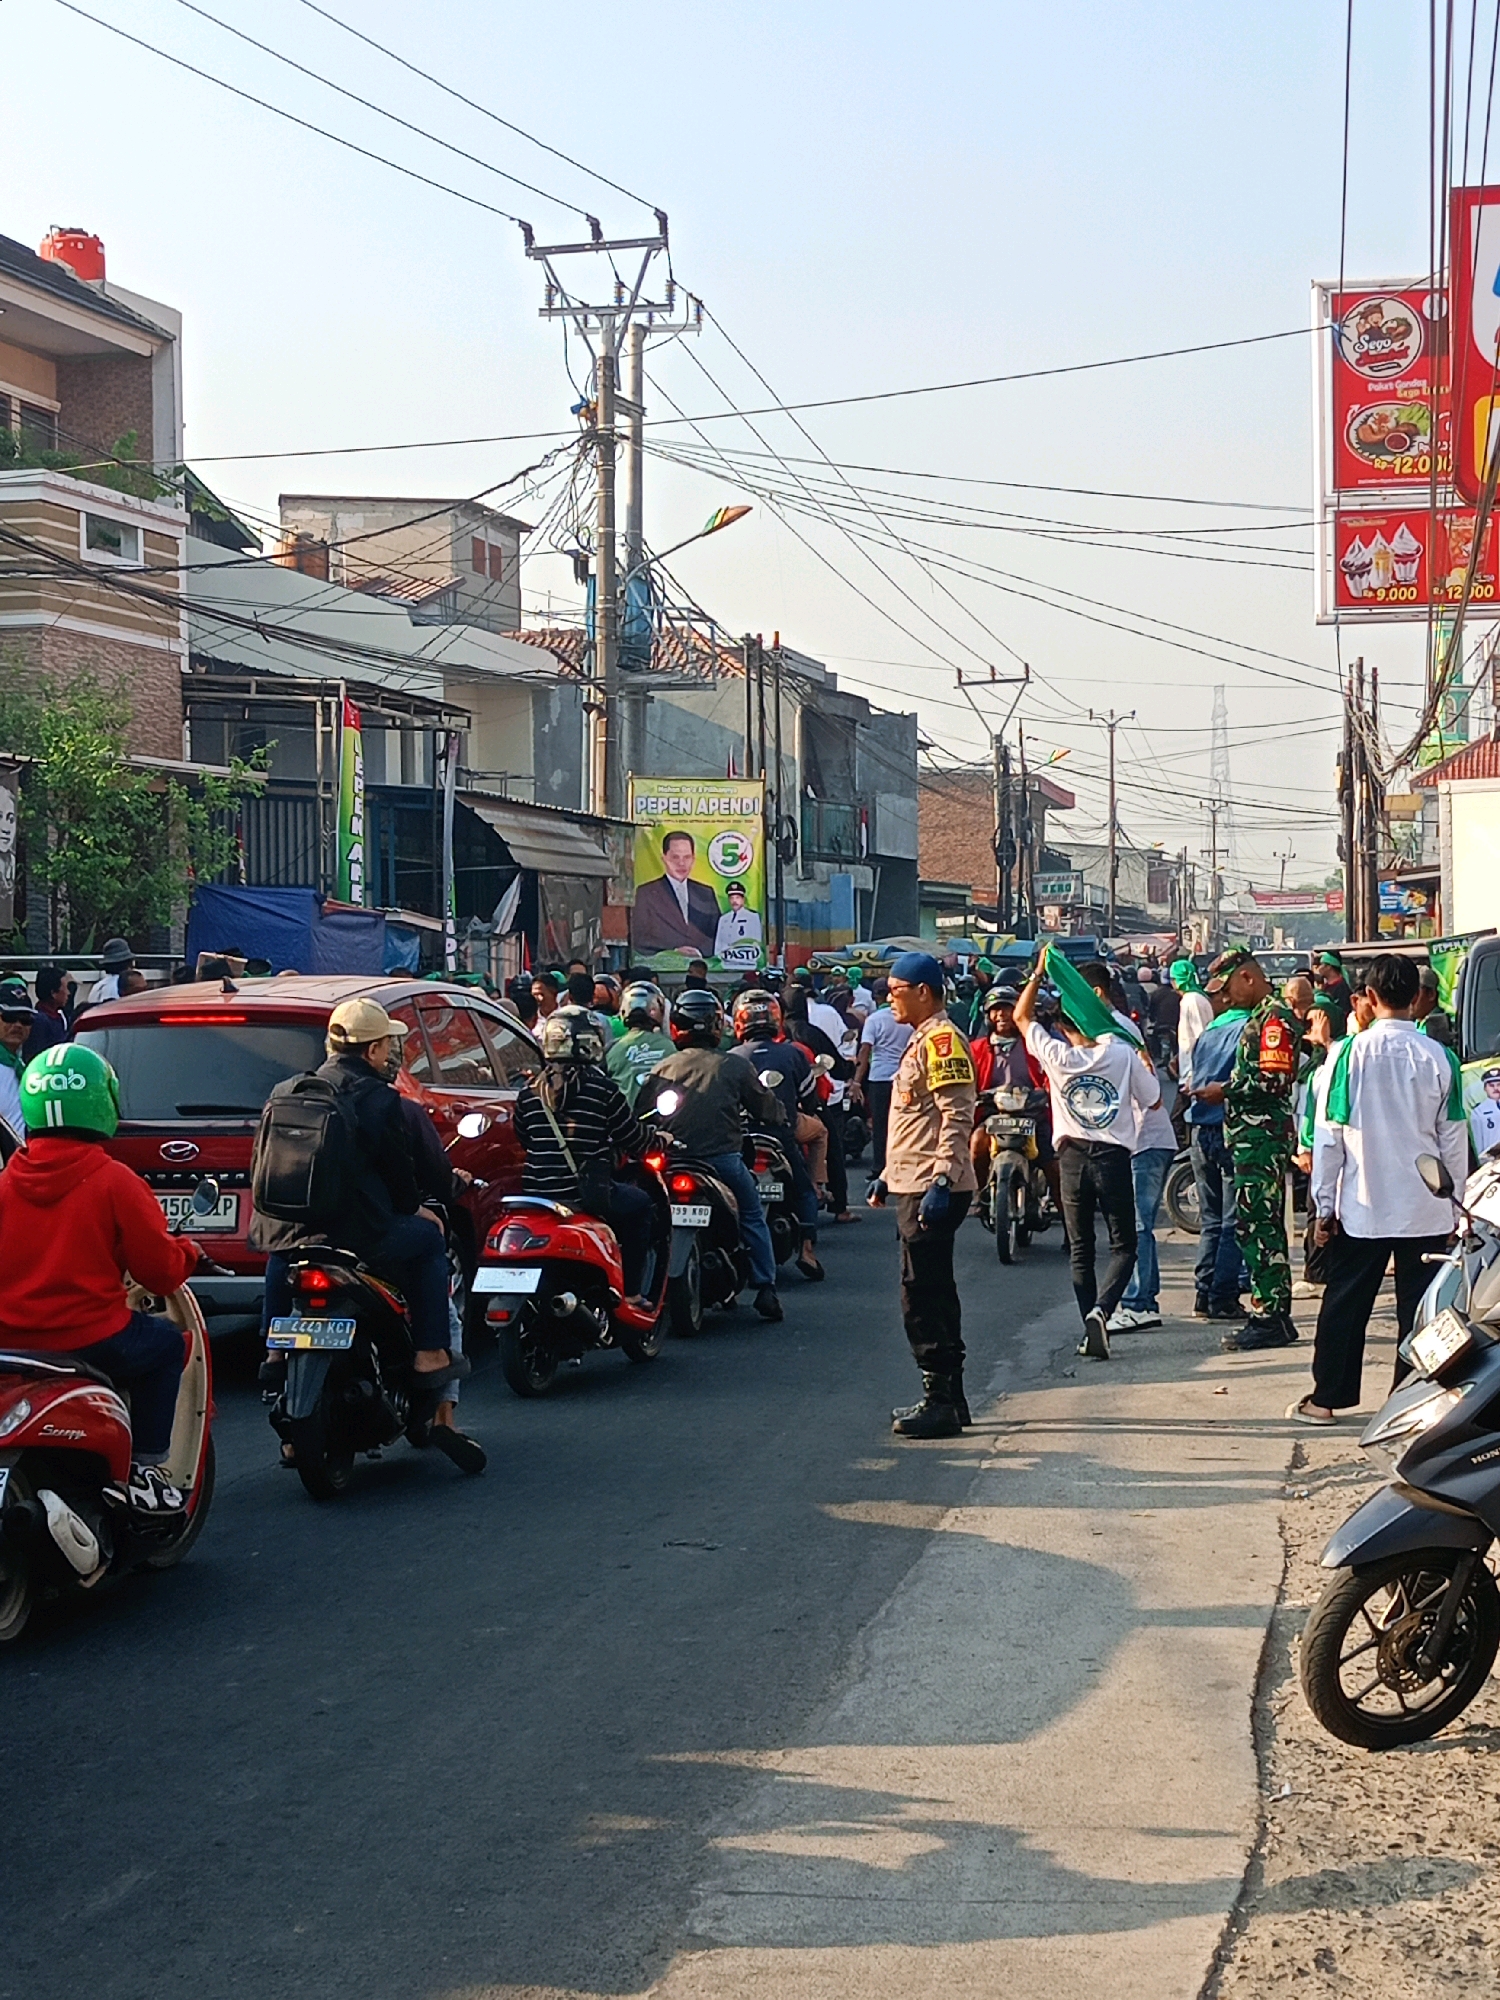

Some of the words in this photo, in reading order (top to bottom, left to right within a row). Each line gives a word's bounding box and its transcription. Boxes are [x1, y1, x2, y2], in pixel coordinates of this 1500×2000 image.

[1353, 333, 1392, 354] Sego
[1376, 586, 1418, 601] 9.000
[636, 797, 693, 815] PEPEN
[695, 797, 760, 816] APENDI
[720, 842, 740, 867] 5
[26, 1067, 86, 1095] Grab
[273, 1320, 281, 1332] B
